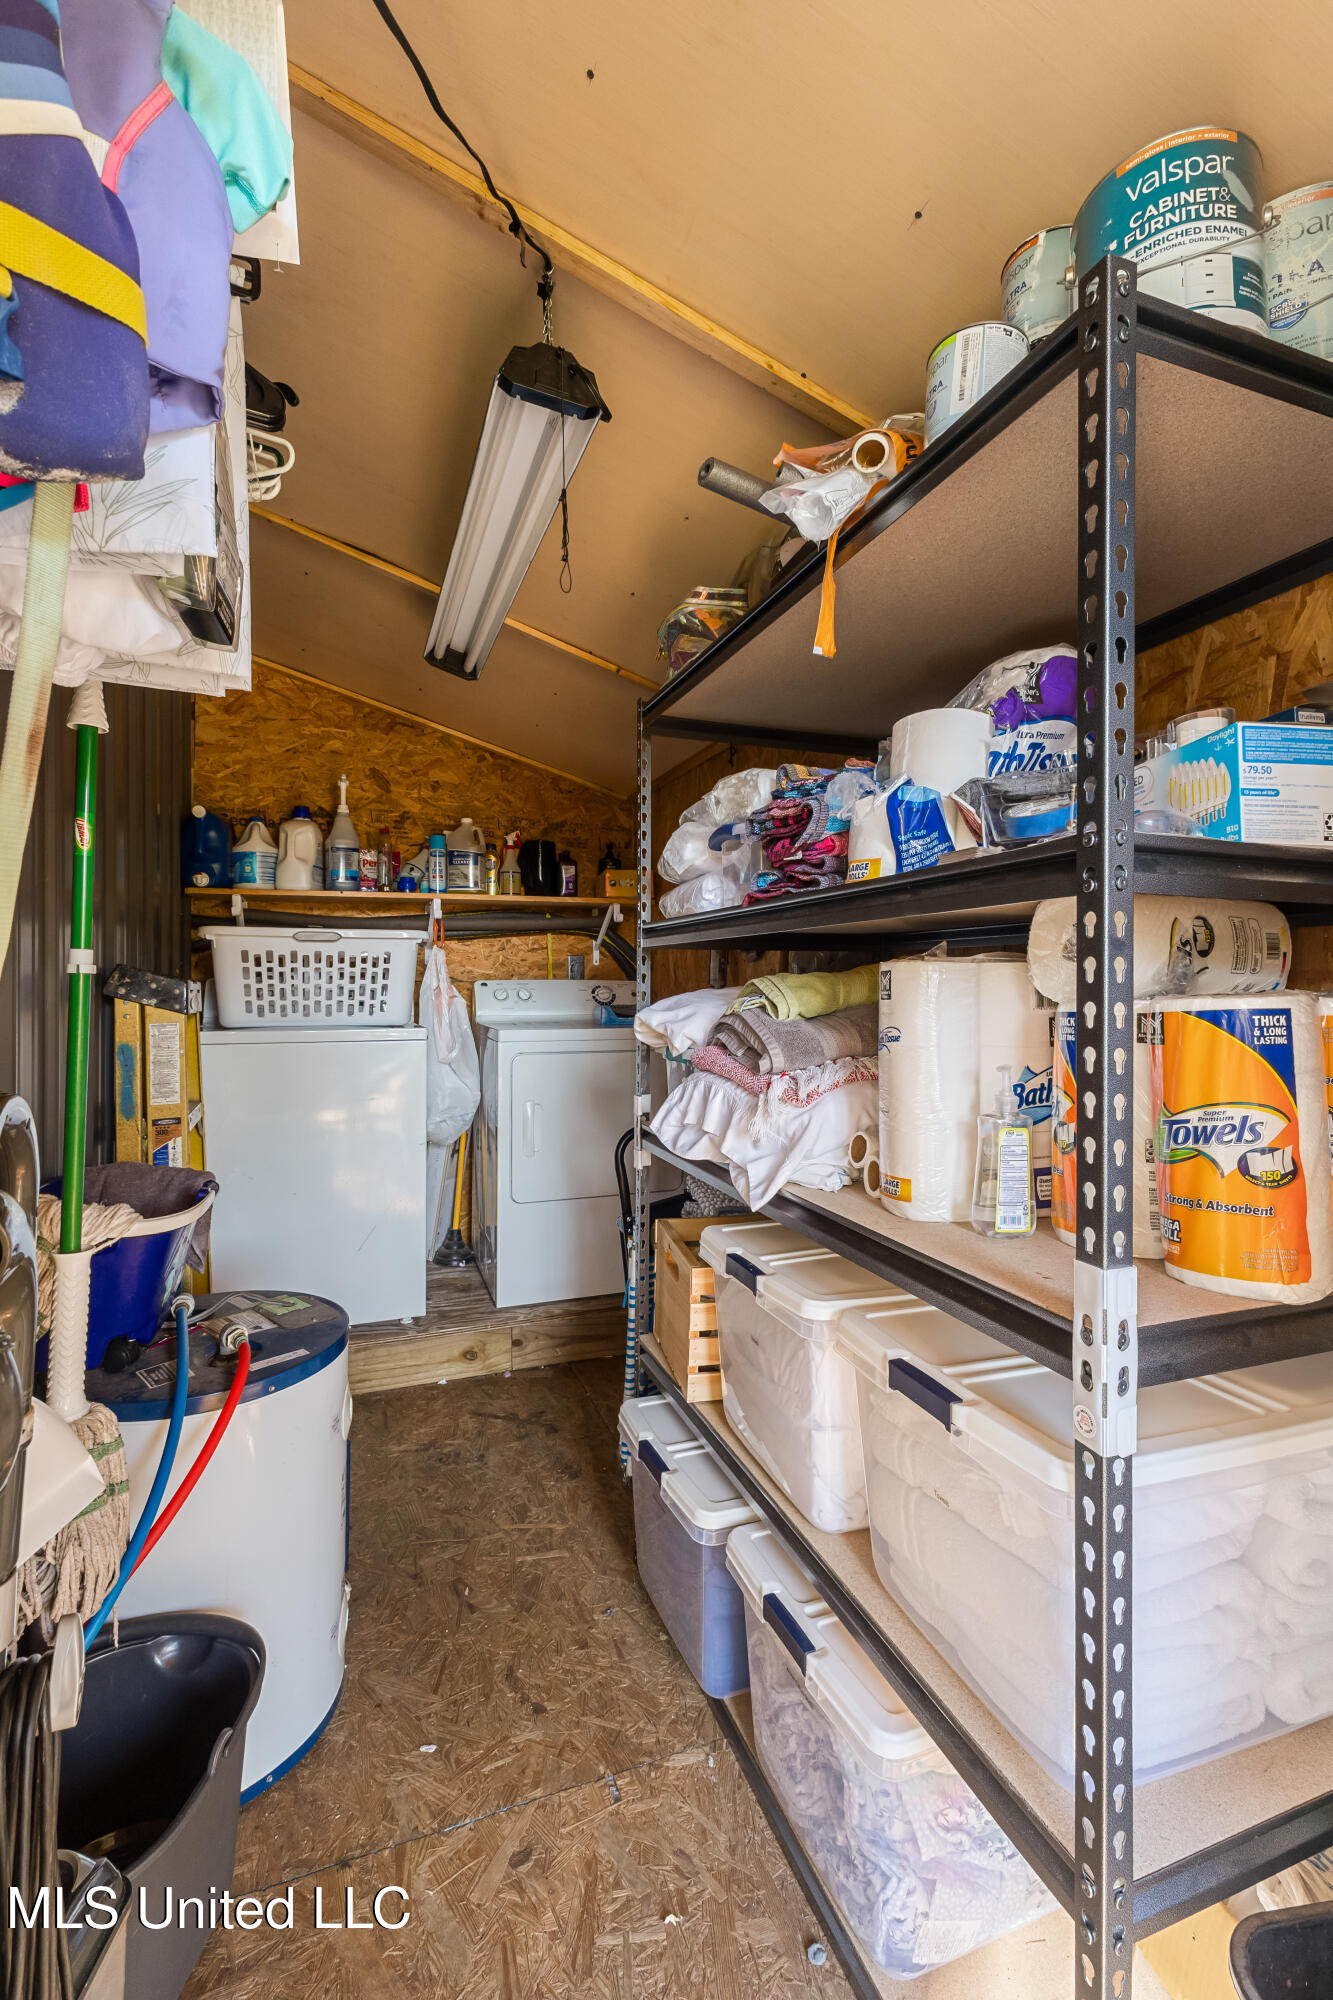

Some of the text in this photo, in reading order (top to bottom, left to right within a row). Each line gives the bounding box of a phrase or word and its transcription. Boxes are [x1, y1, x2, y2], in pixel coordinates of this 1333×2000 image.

[1125, 154, 1231, 202] valspar
[1124, 203, 1238, 250] FURNITURE
[1135, 226, 1202, 259] ENRICHED
[1189, 236, 1230, 244] DURABILITY
[1036, 731, 1065, 740] Premium
[1207, 727, 1235, 743] Daylight
[1252, 1015, 1287, 1026] THICK
[1253, 1027, 1287, 1036] & LONG
[1254, 1036, 1288, 1045] LASTING
[1162, 1115, 1264, 1153] Towels
[1260, 1170, 1281, 1180] 150
[1164, 1192, 1275, 1217] Strong & Absorbent
